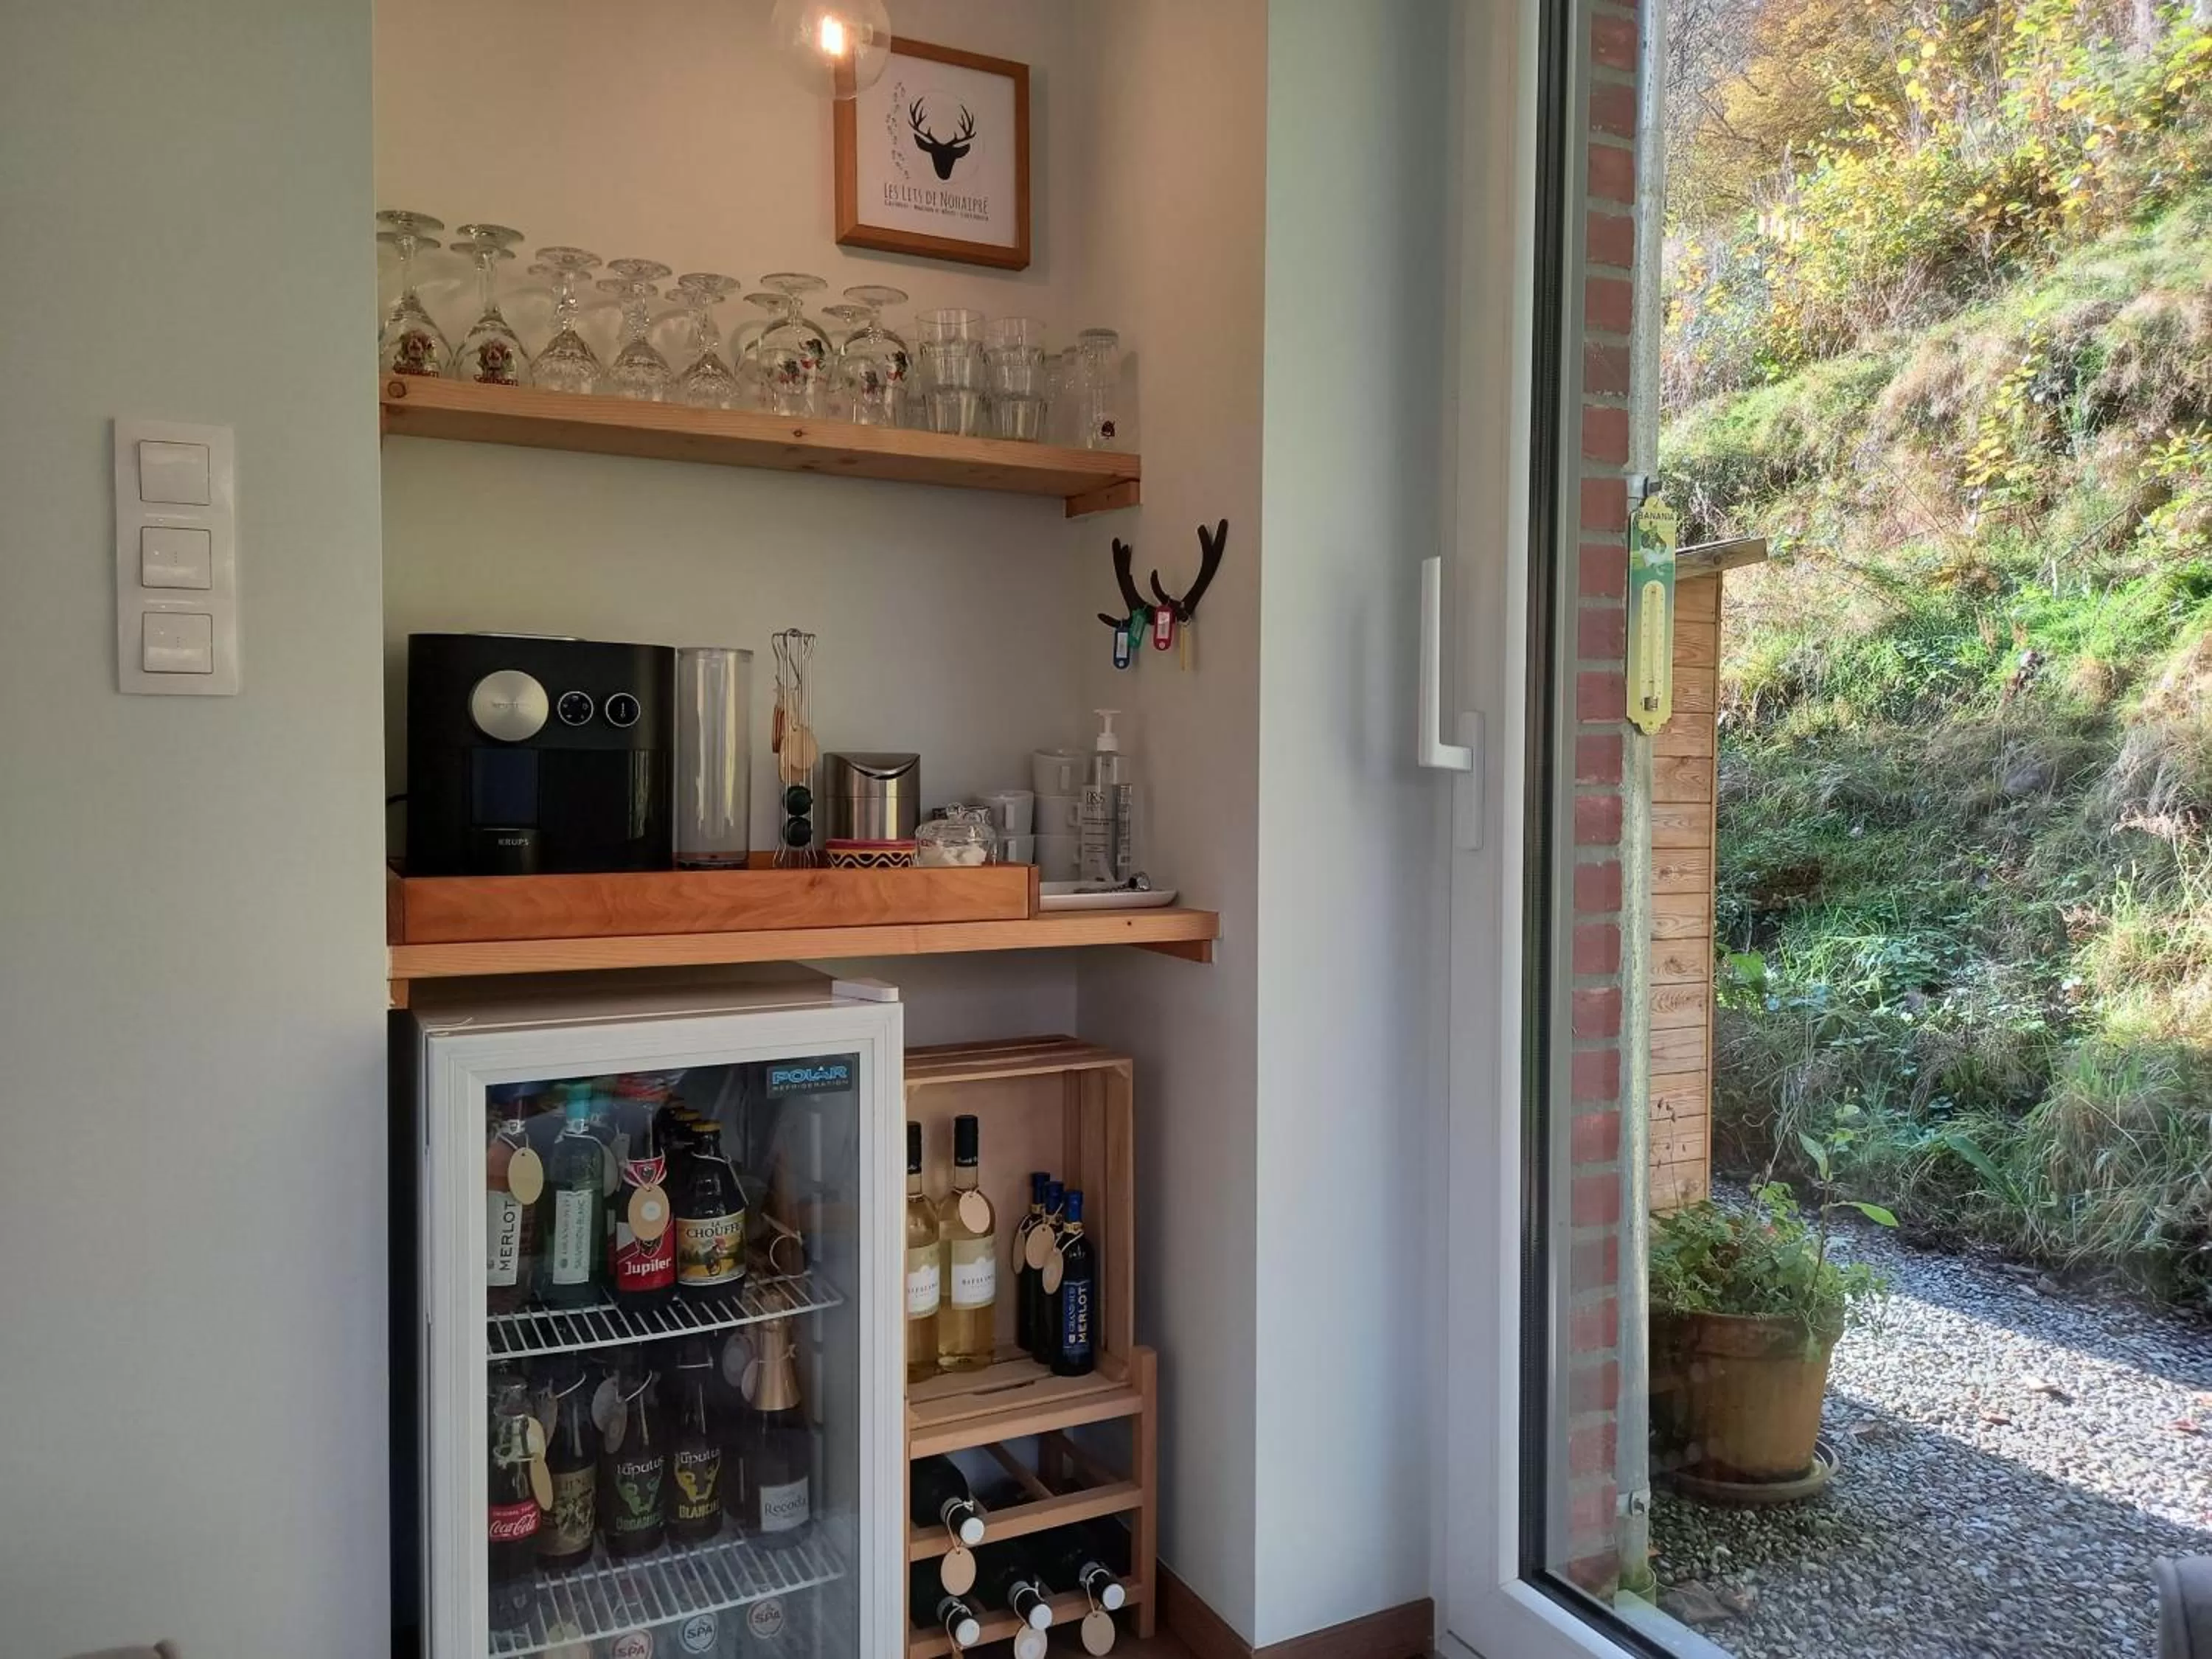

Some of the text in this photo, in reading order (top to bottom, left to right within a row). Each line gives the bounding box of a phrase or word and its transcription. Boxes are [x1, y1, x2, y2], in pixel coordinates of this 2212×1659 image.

[498, 837, 529, 846] KRUPS
[772, 1065, 848, 1085] POLAR
[772, 1079, 849, 1091] REFRIGERATION
[499, 1200, 516, 1270] MERLOT
[625, 1256, 672, 1277] Jupiler
[1077, 1286, 1088, 1343] MERLOT
[489, 1511, 538, 1537] Coca-Cola
[754, 1609, 782, 1624] SPA
[686, 1625, 713, 1639] SPA
[616, 1644, 646, 1658] SPA
